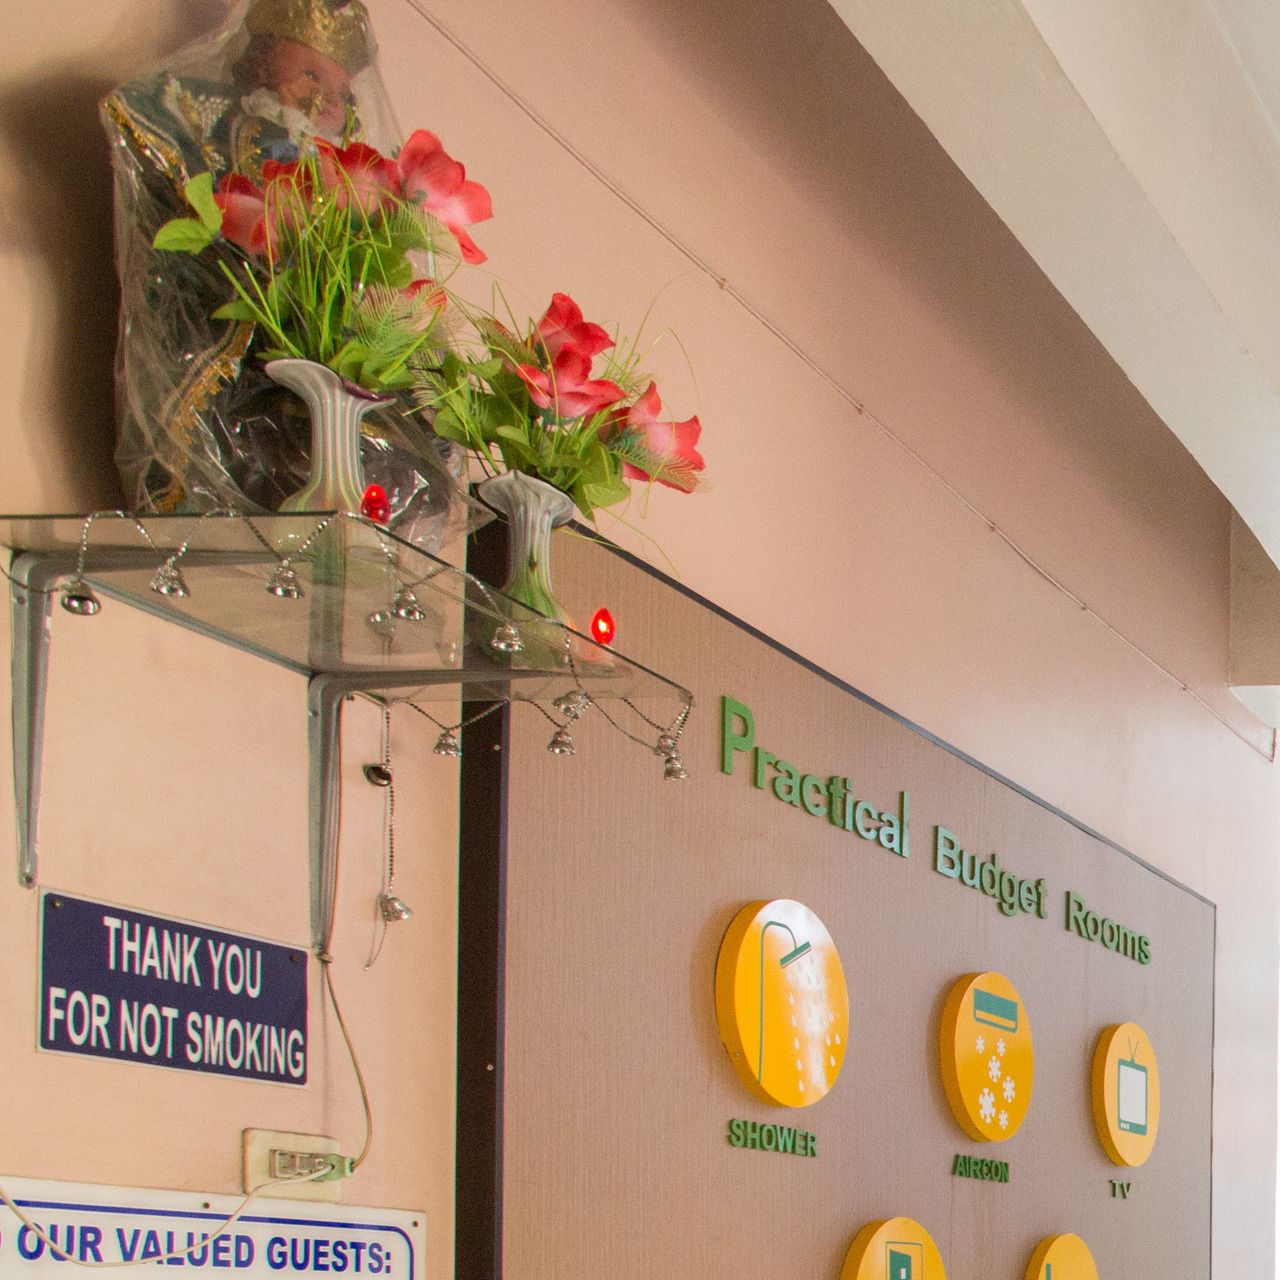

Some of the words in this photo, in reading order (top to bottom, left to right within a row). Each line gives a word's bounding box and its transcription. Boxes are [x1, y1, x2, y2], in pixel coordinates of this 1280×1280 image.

[720, 694, 911, 858] Practical
[934, 825, 1049, 919] Budget
[1065, 890, 1152, 965] Rooms
[102, 914, 202, 987] THANK
[207, 939, 263, 998] YOU
[47, 986, 111, 1050] FOR
[119, 999, 179, 1059] NOT
[184, 1011, 305, 1079] SMOKING
[727, 1118, 818, 1157] SHOWER
[952, 1153, 1010, 1183] AIRCON
[1108, 1178, 1133, 1199] TV
[17, 1222, 104, 1263] OUR
[117, 1227, 255, 1268] VALUED
[266, 1236, 391, 1274] GUESTS:
